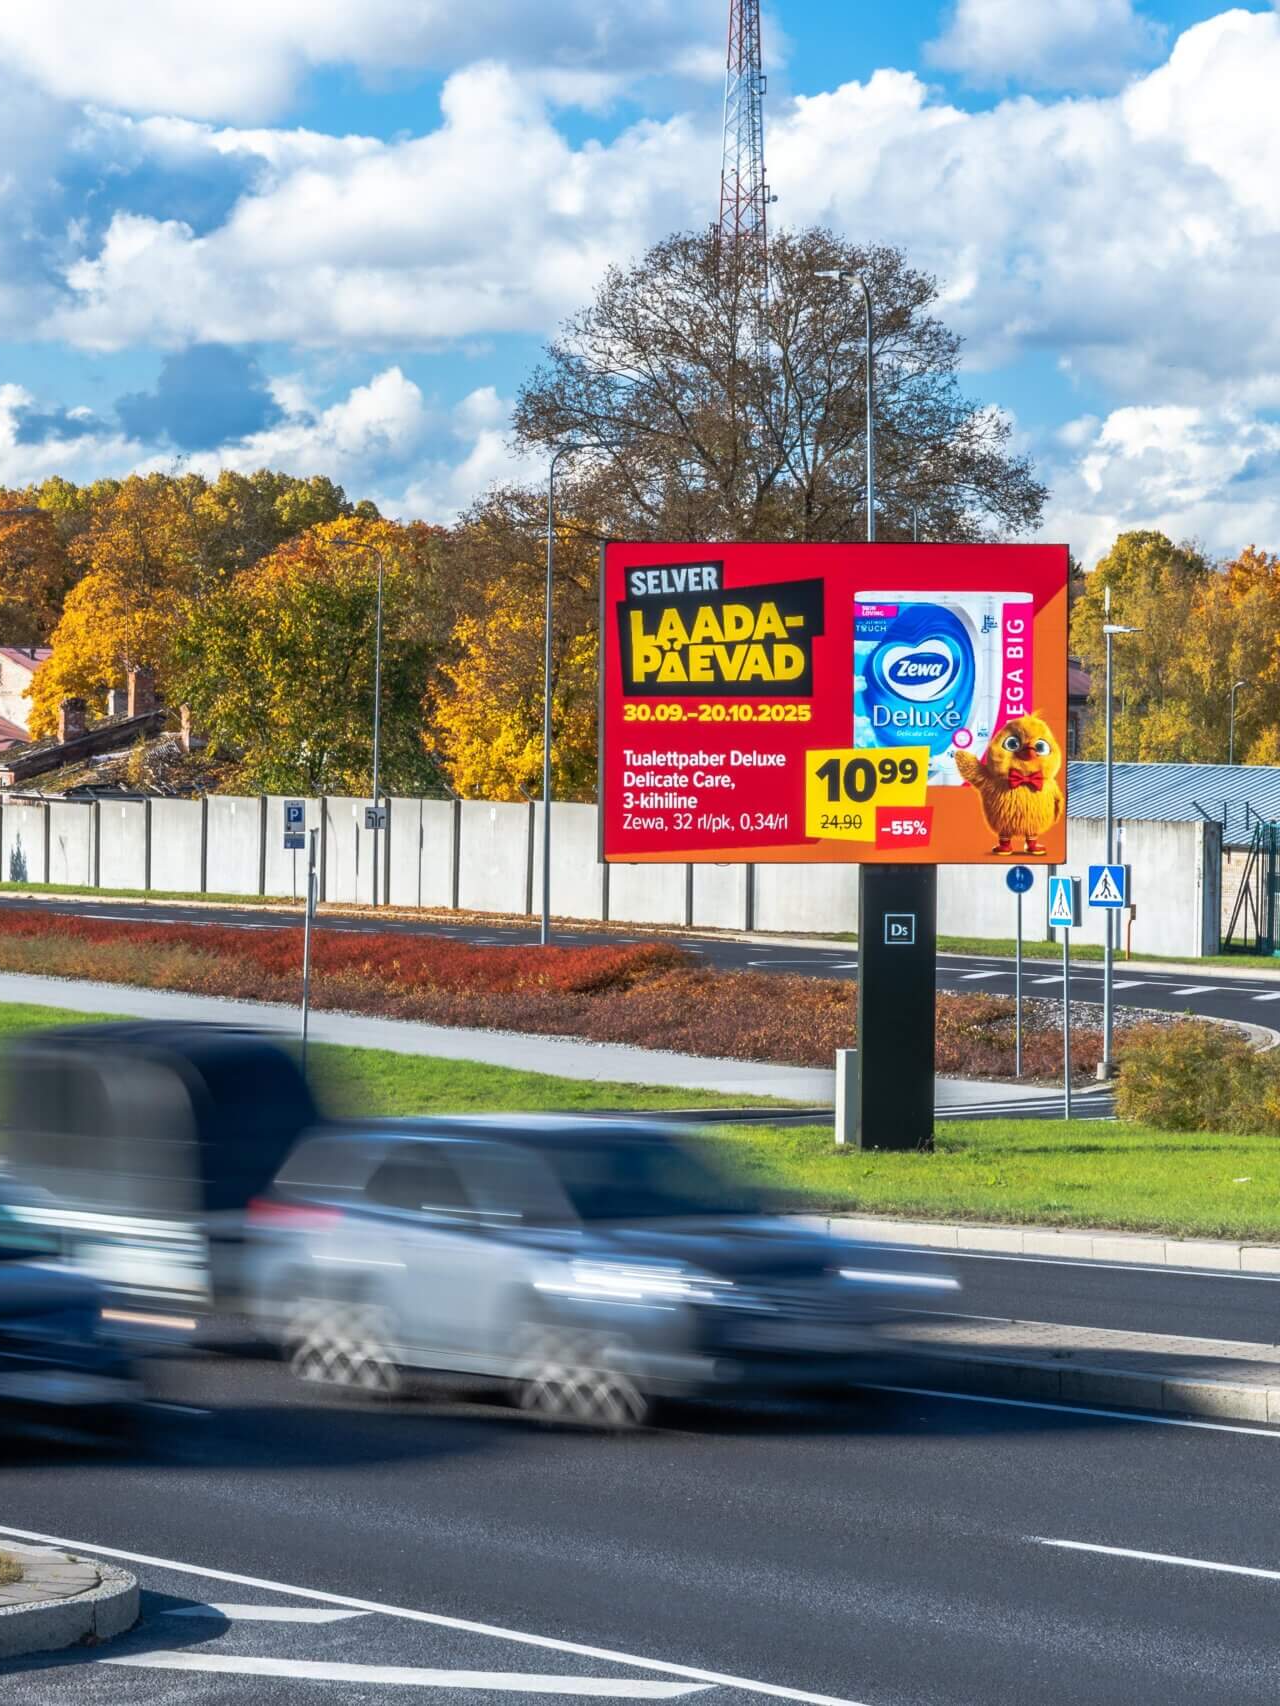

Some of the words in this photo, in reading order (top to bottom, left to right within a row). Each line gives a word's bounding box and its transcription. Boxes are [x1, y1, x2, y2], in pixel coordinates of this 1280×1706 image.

[630, 564, 719, 596] SELVER
[630, 601, 804, 646] LAADA-
[1006, 619, 1025, 659] BIG
[631, 638, 806, 683] PÄEVAD
[896, 660, 943, 677] Zewa
[1006, 668, 1025, 720] EGA
[623, 749, 726, 770] Tualettpaber
[730, 750, 787, 767] Deluxe
[623, 771, 689, 789] Delicate
[692, 771, 736, 790] Care,
[623, 792, 699, 810] 3-kihiline
[622, 813, 669, 832] Zewa,
[673, 813, 694, 830] 32
[697, 812, 735, 833] rl/pk,
[739, 812, 789, 832] 0,34/rl
[891, 923, 909, 937] Ds
